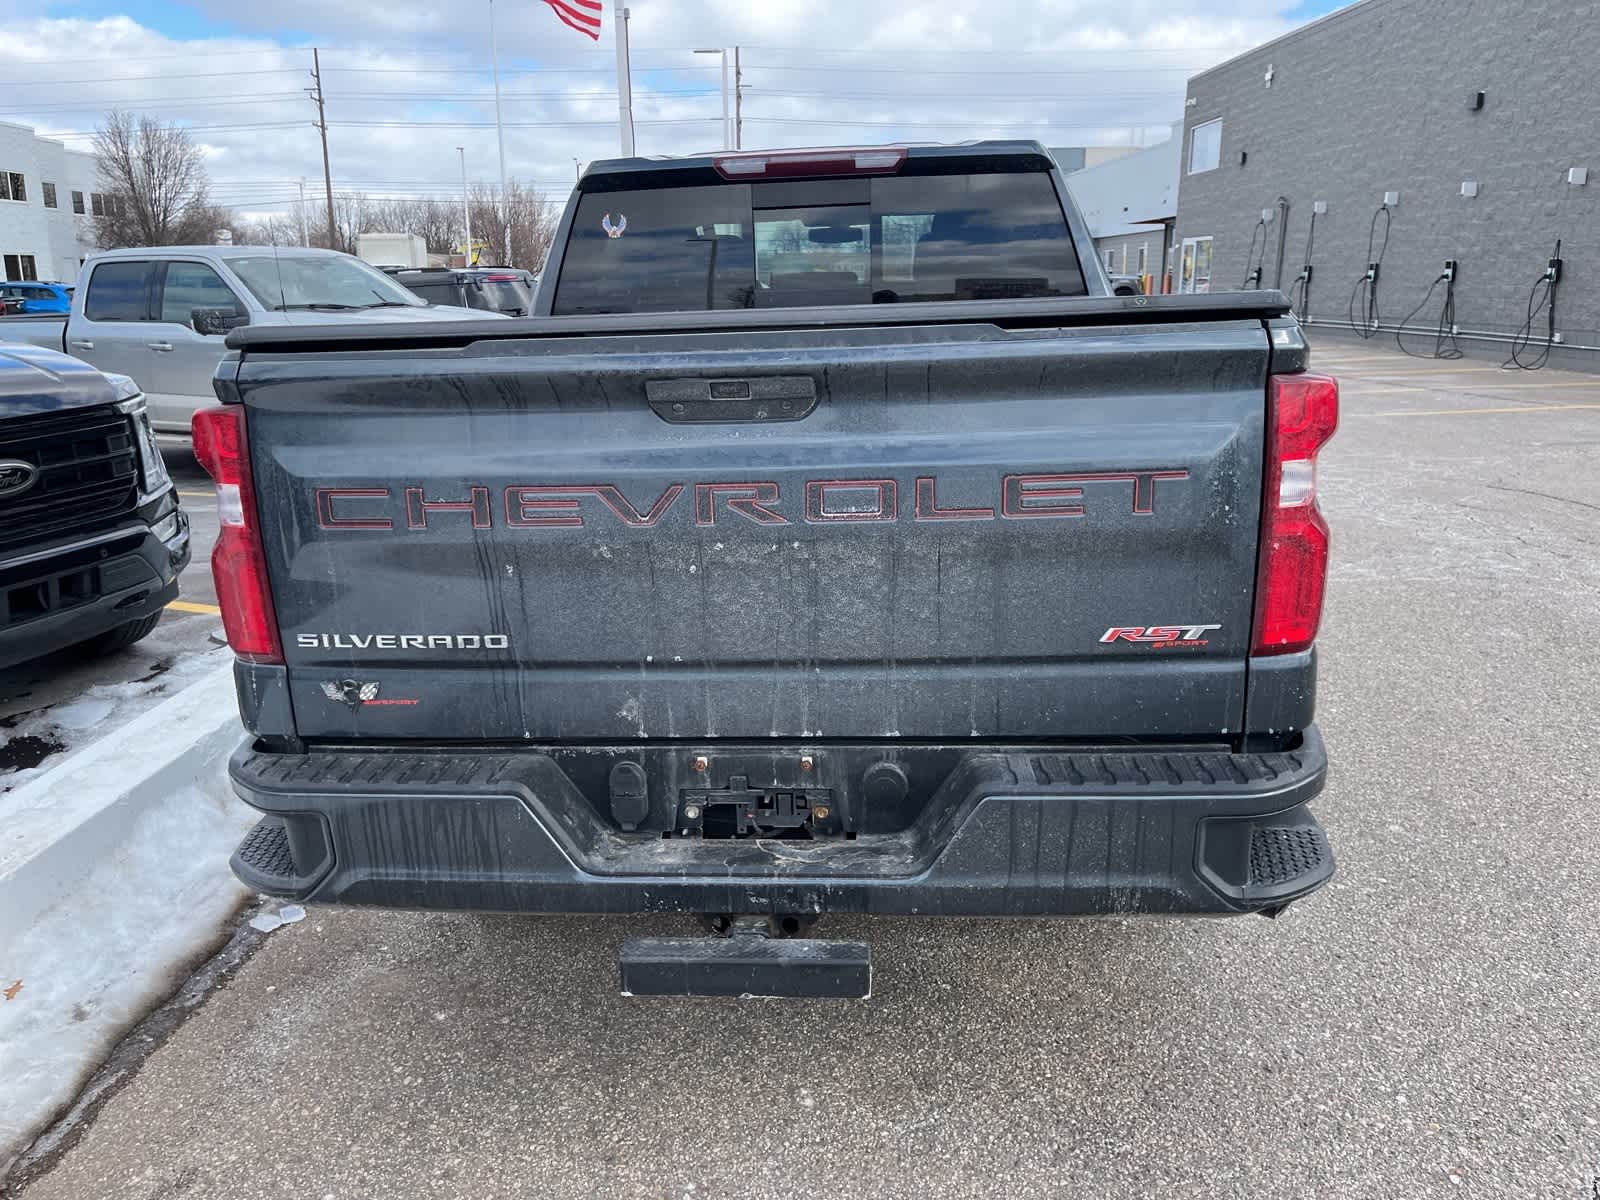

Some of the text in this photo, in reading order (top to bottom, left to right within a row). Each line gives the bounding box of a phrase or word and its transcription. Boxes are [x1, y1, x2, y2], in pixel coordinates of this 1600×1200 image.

[0, 470, 22, 488] ord
[315, 470, 1190, 531] CHEVROLET
[296, 633, 509, 649] SILVERADO
[1099, 624, 1222, 643] RST
